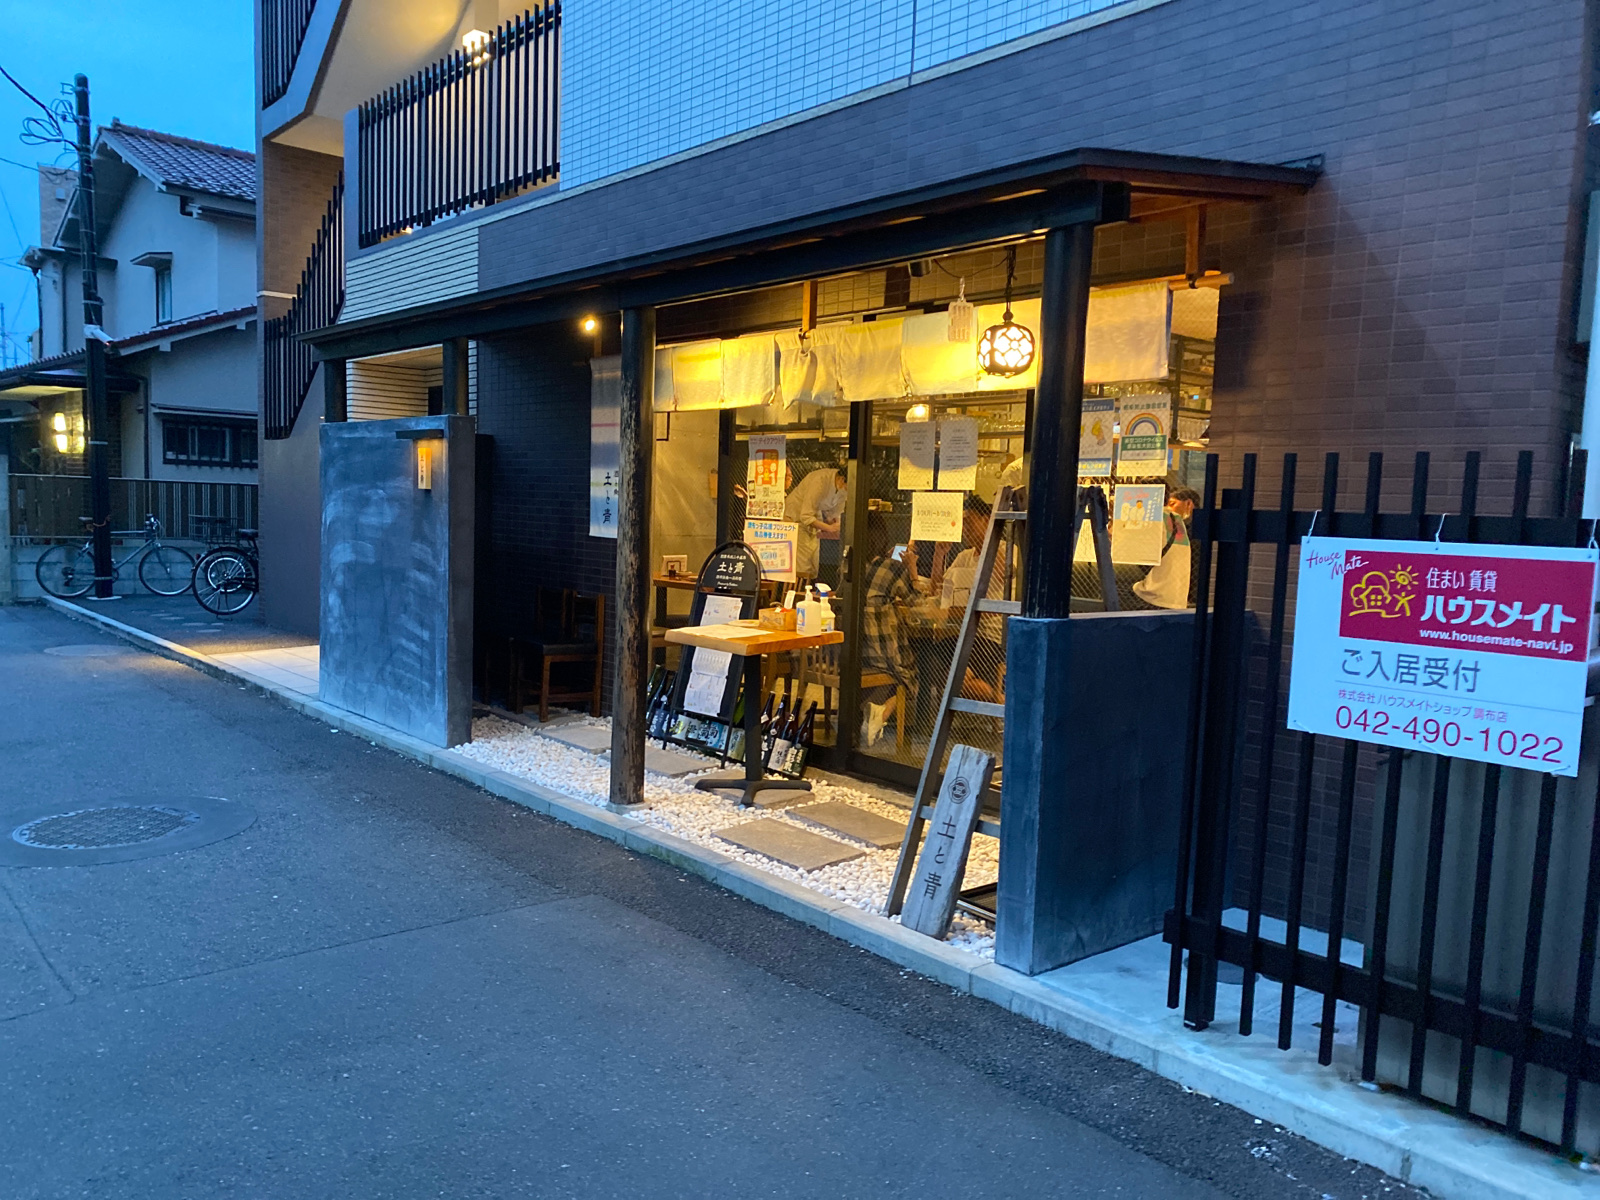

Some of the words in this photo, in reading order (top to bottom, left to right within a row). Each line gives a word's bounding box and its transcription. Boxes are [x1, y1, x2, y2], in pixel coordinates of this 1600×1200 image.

[602, 471, 612, 525] 土と青
[716, 561, 745, 575] 土と青
[1306, 550, 1342, 570] House
[1331, 555, 1370, 580] Mate
[1426, 567, 1465, 590] 住まい
[1469, 569, 1498, 593] 賃貸
[1420, 595, 1577, 634] ハウスメイト
[1419, 628, 1574, 654] www.housemate-navi.jp
[1341, 648, 1481, 694] ご入居受付
[1337, 689, 1377, 705] 株式会社
[1377, 694, 1472, 719] ハウスメイトショップ
[1473, 707, 1508, 724] 調布店
[1335, 705, 1564, 765] 042-490-1022
[923, 815, 957, 901] 土と青
